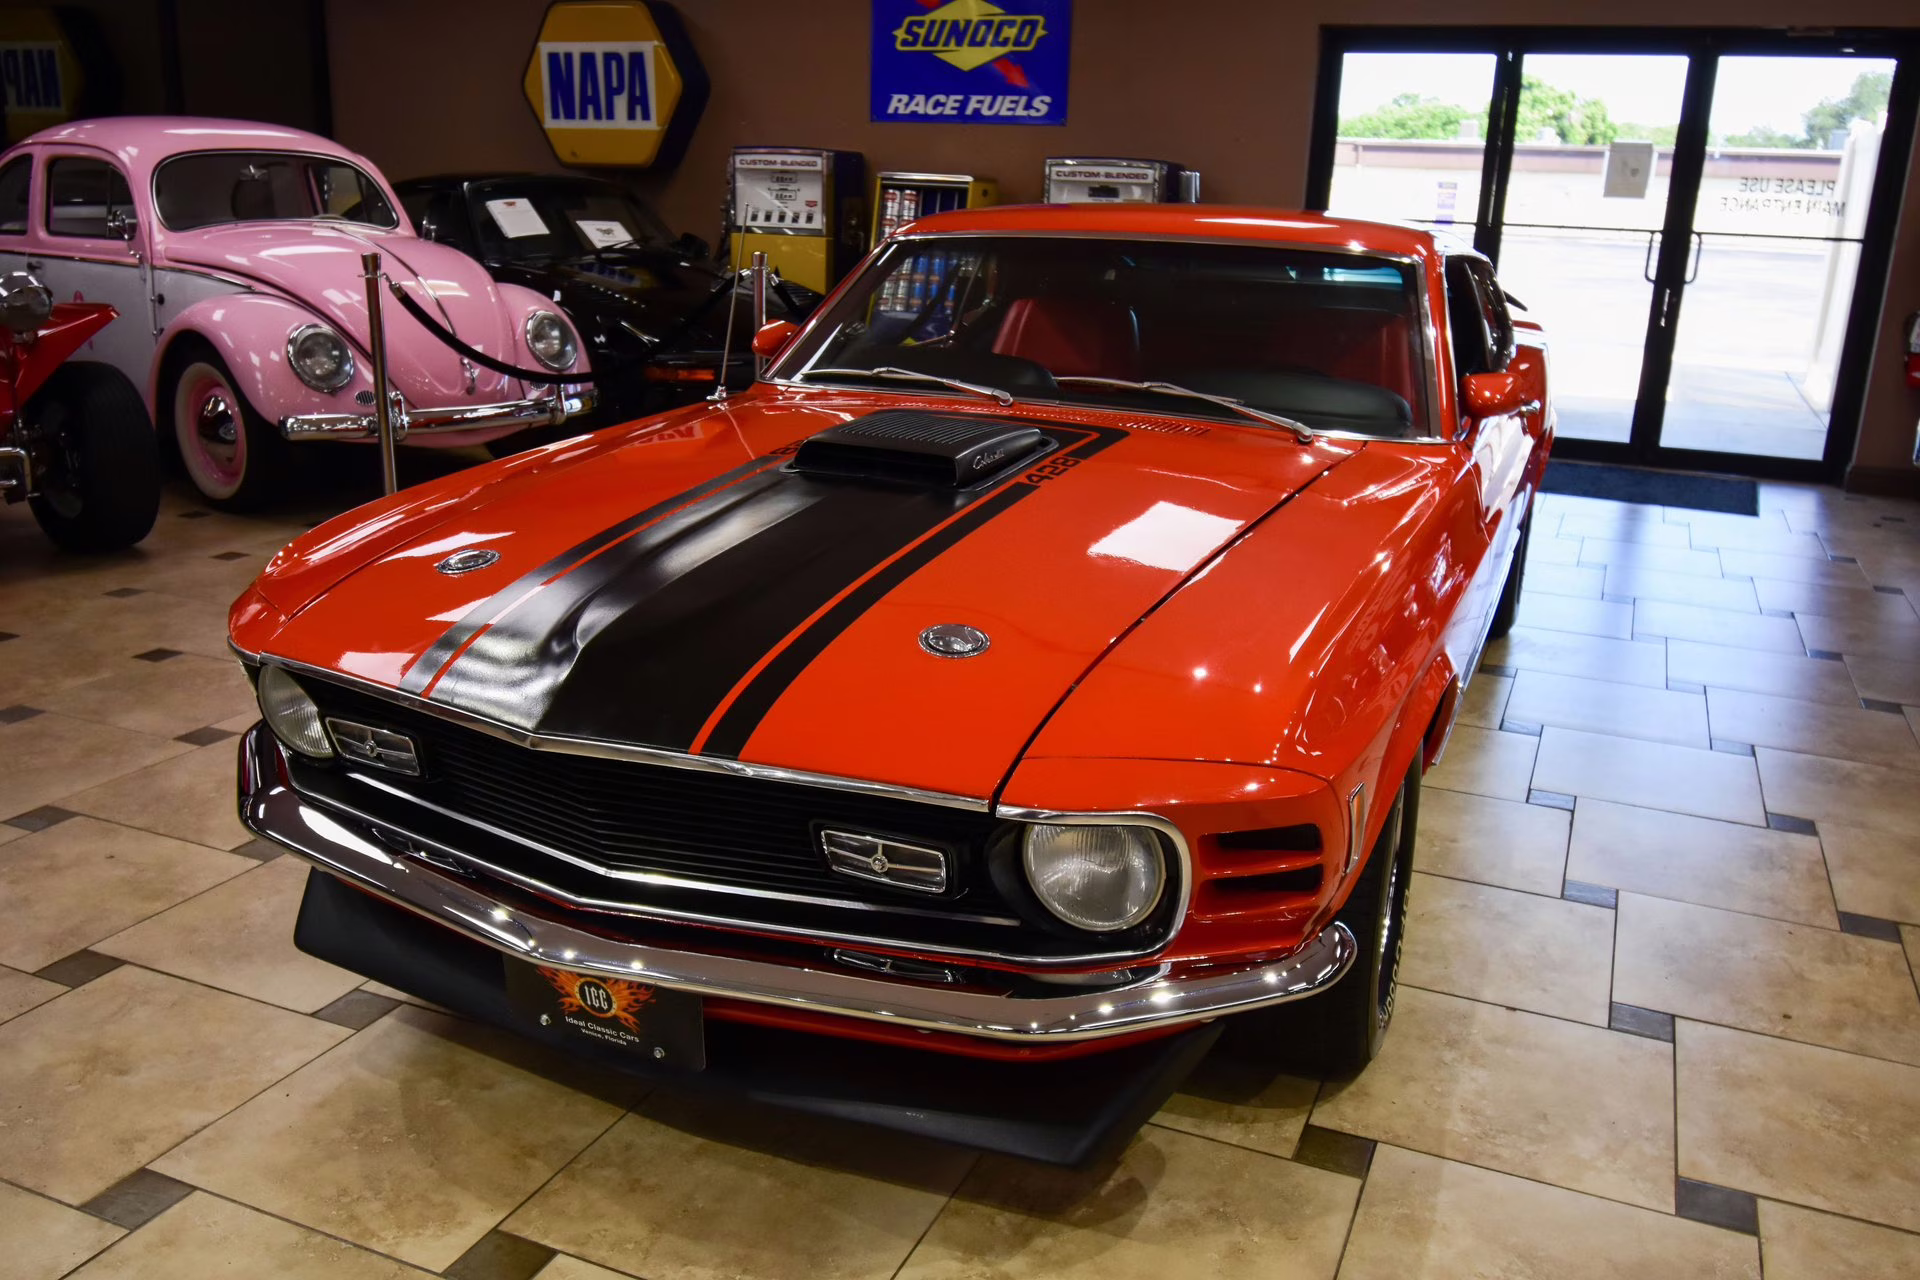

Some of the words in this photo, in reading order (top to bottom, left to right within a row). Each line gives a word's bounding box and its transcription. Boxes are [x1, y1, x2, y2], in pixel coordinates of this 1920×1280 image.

[900, 19, 1039, 48] SUNOCO
[546, 51, 652, 121] NAPA
[886, 93, 964, 116] RACE
[964, 94, 1053, 117] FUELS
[1055, 170, 1149, 181] CUSTOM-BLENDED
[1024, 455, 1082, 486] 428
[584, 984, 609, 1011] ICC
[564, 1015, 586, 1027] Ideal
[587, 1022, 618, 1037] Classic
[619, 1031, 640, 1043] Cars
[604, 1034, 627, 1046] Florida
